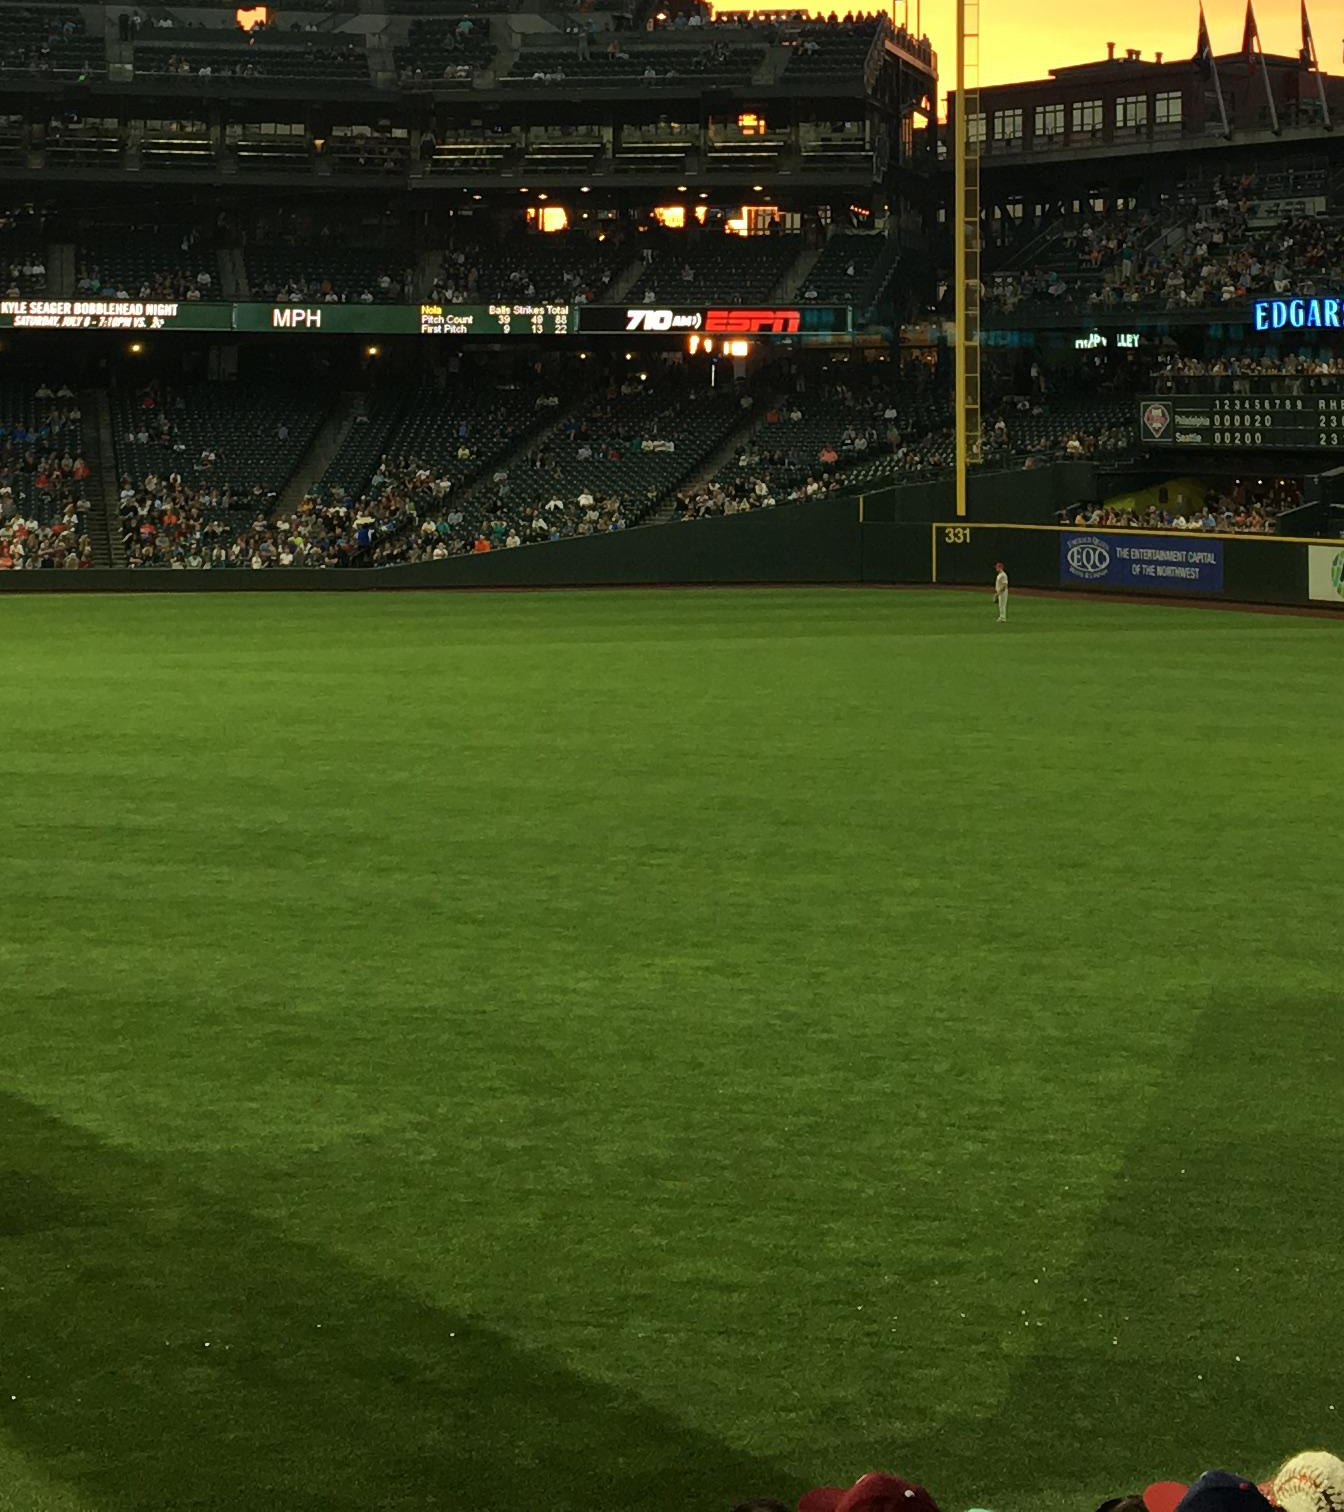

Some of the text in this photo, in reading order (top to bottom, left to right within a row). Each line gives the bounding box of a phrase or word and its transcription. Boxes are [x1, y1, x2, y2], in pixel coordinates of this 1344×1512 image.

[0, 301, 178, 316] KYLE SEAGER BOBBLEHEAD NIGHT
[421, 305, 569, 315] Nola Balls Strikes Total
[61, 316, 82, 327] JULY
[272, 309, 321, 327] MPH
[421, 315, 444, 324] Pitch
[446, 315, 473, 324] Count
[498, 315, 511, 324] 39
[530, 315, 543, 324] 49
[625, 310, 673, 331] 710
[706, 310, 801, 333] ESPN
[421, 325, 567, 334] First Pitch 9 13 22
[1175, 432, 1202, 443] Seattle
[945, 527, 971, 543] 331
[1073, 547, 1108, 572] EQC
[1116, 547, 1216, 565] THE ENTERTAINMENT CAPITAL
[1132, 564, 1200, 579] OF THE NORTHWEST
